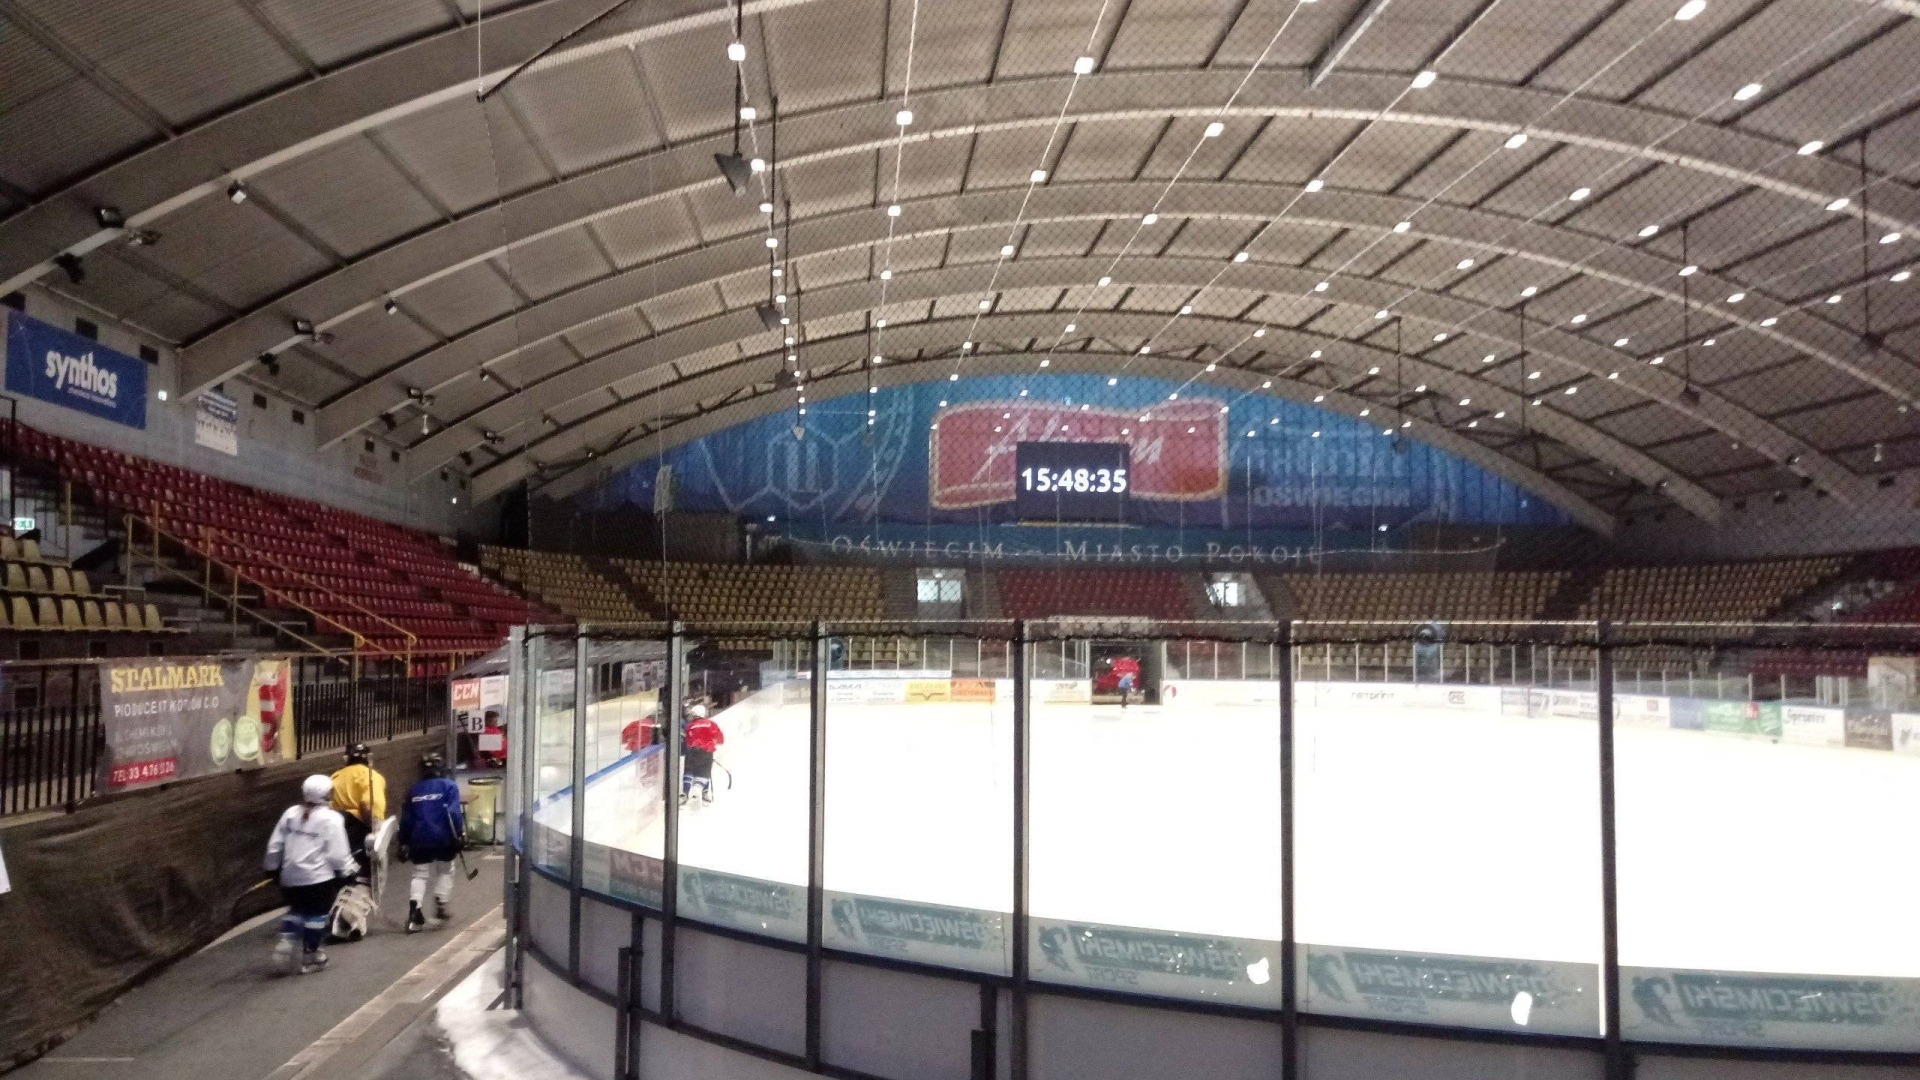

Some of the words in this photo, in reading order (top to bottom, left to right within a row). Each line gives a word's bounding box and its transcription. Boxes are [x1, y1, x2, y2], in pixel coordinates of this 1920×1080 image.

[45, 350, 118, 399] synthos
[1021, 467, 1128, 494] 15:48:35
[1064, 539, 1183, 563] MIASTO
[111, 664, 224, 693] STALMARK
[453, 681, 480, 701] CCM
[471, 716, 483, 731] B
